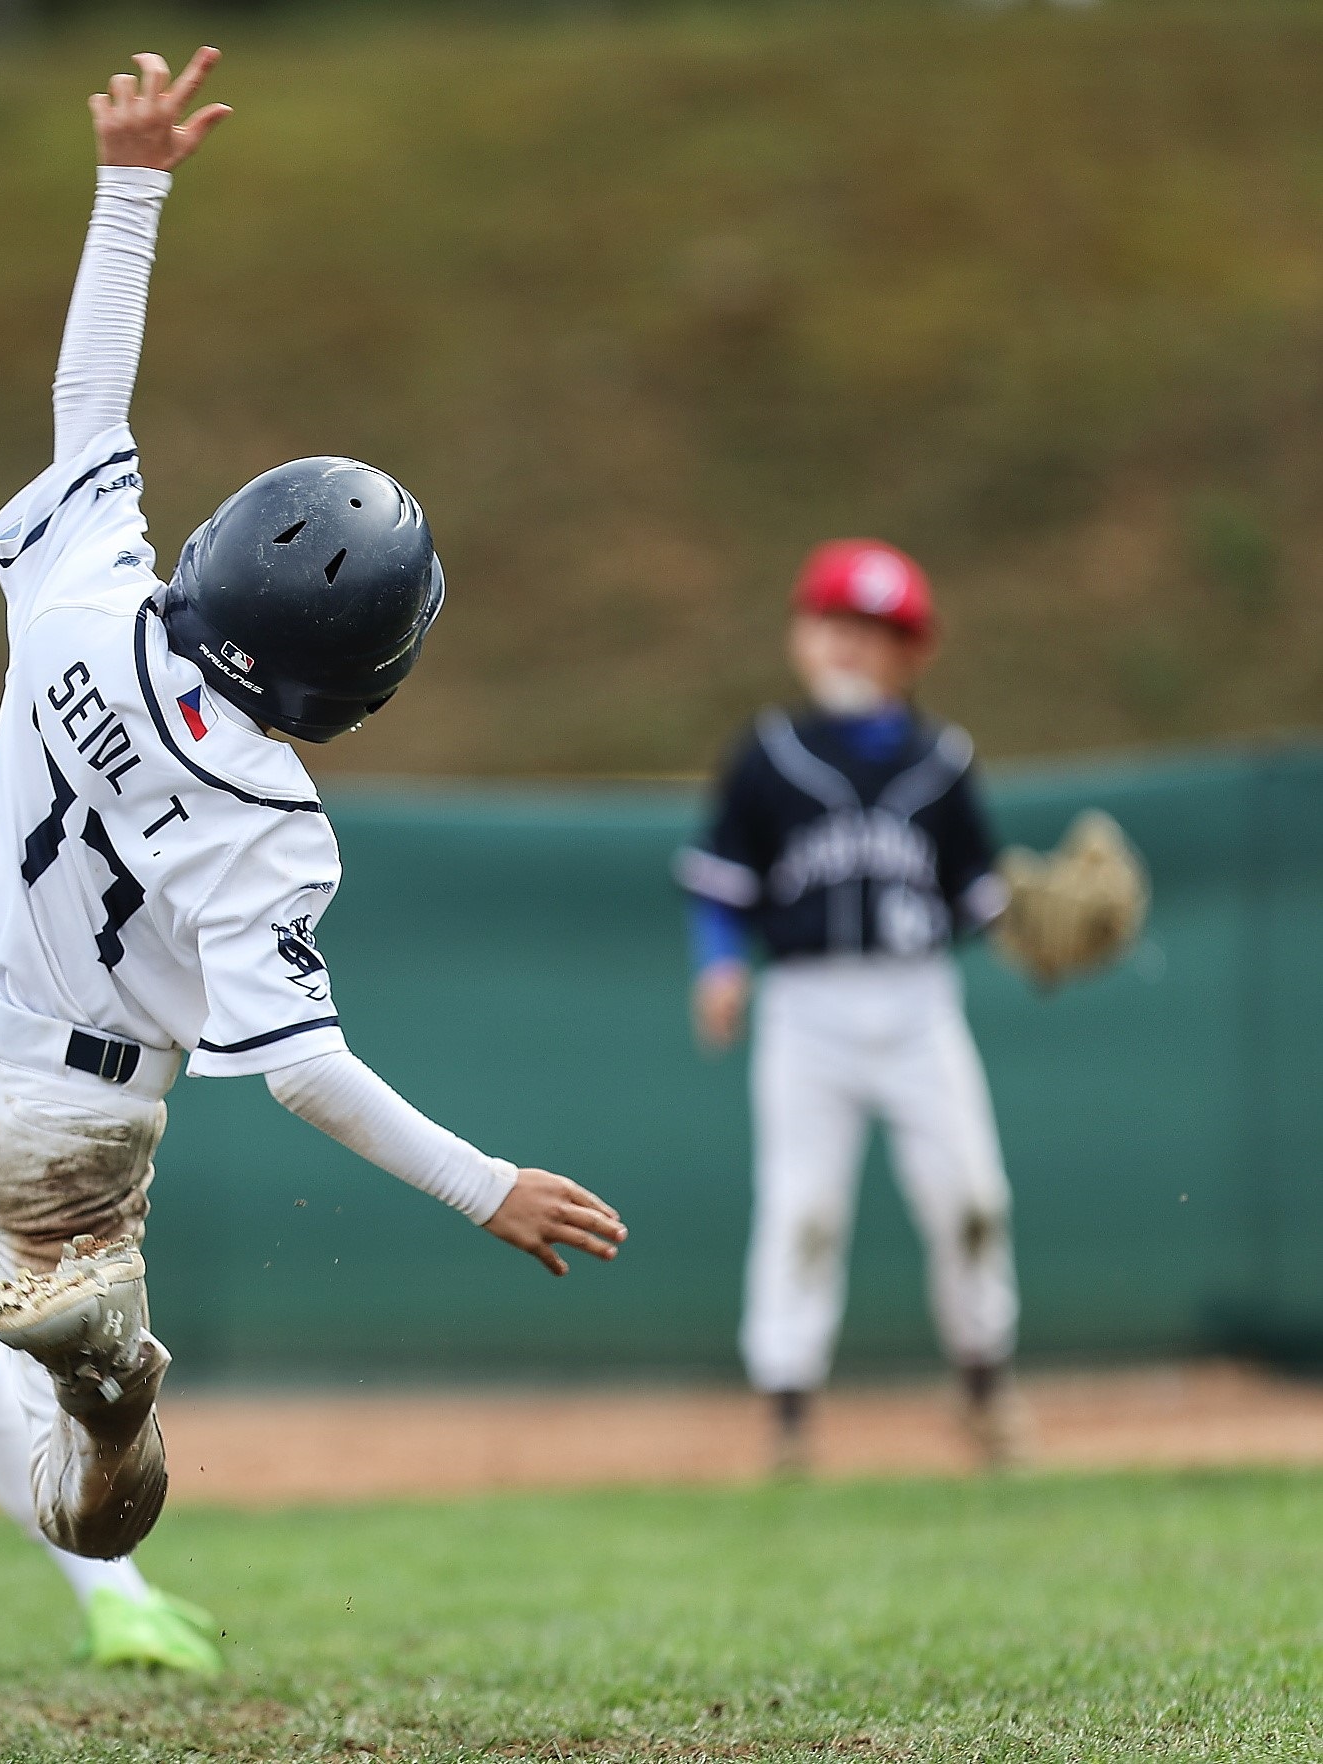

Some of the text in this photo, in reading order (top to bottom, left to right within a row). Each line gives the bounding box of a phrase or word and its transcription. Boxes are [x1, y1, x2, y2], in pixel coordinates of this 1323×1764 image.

[198, 642, 265, 695] RAWLINGS
[47, 661, 190, 858] SEIDL T.
